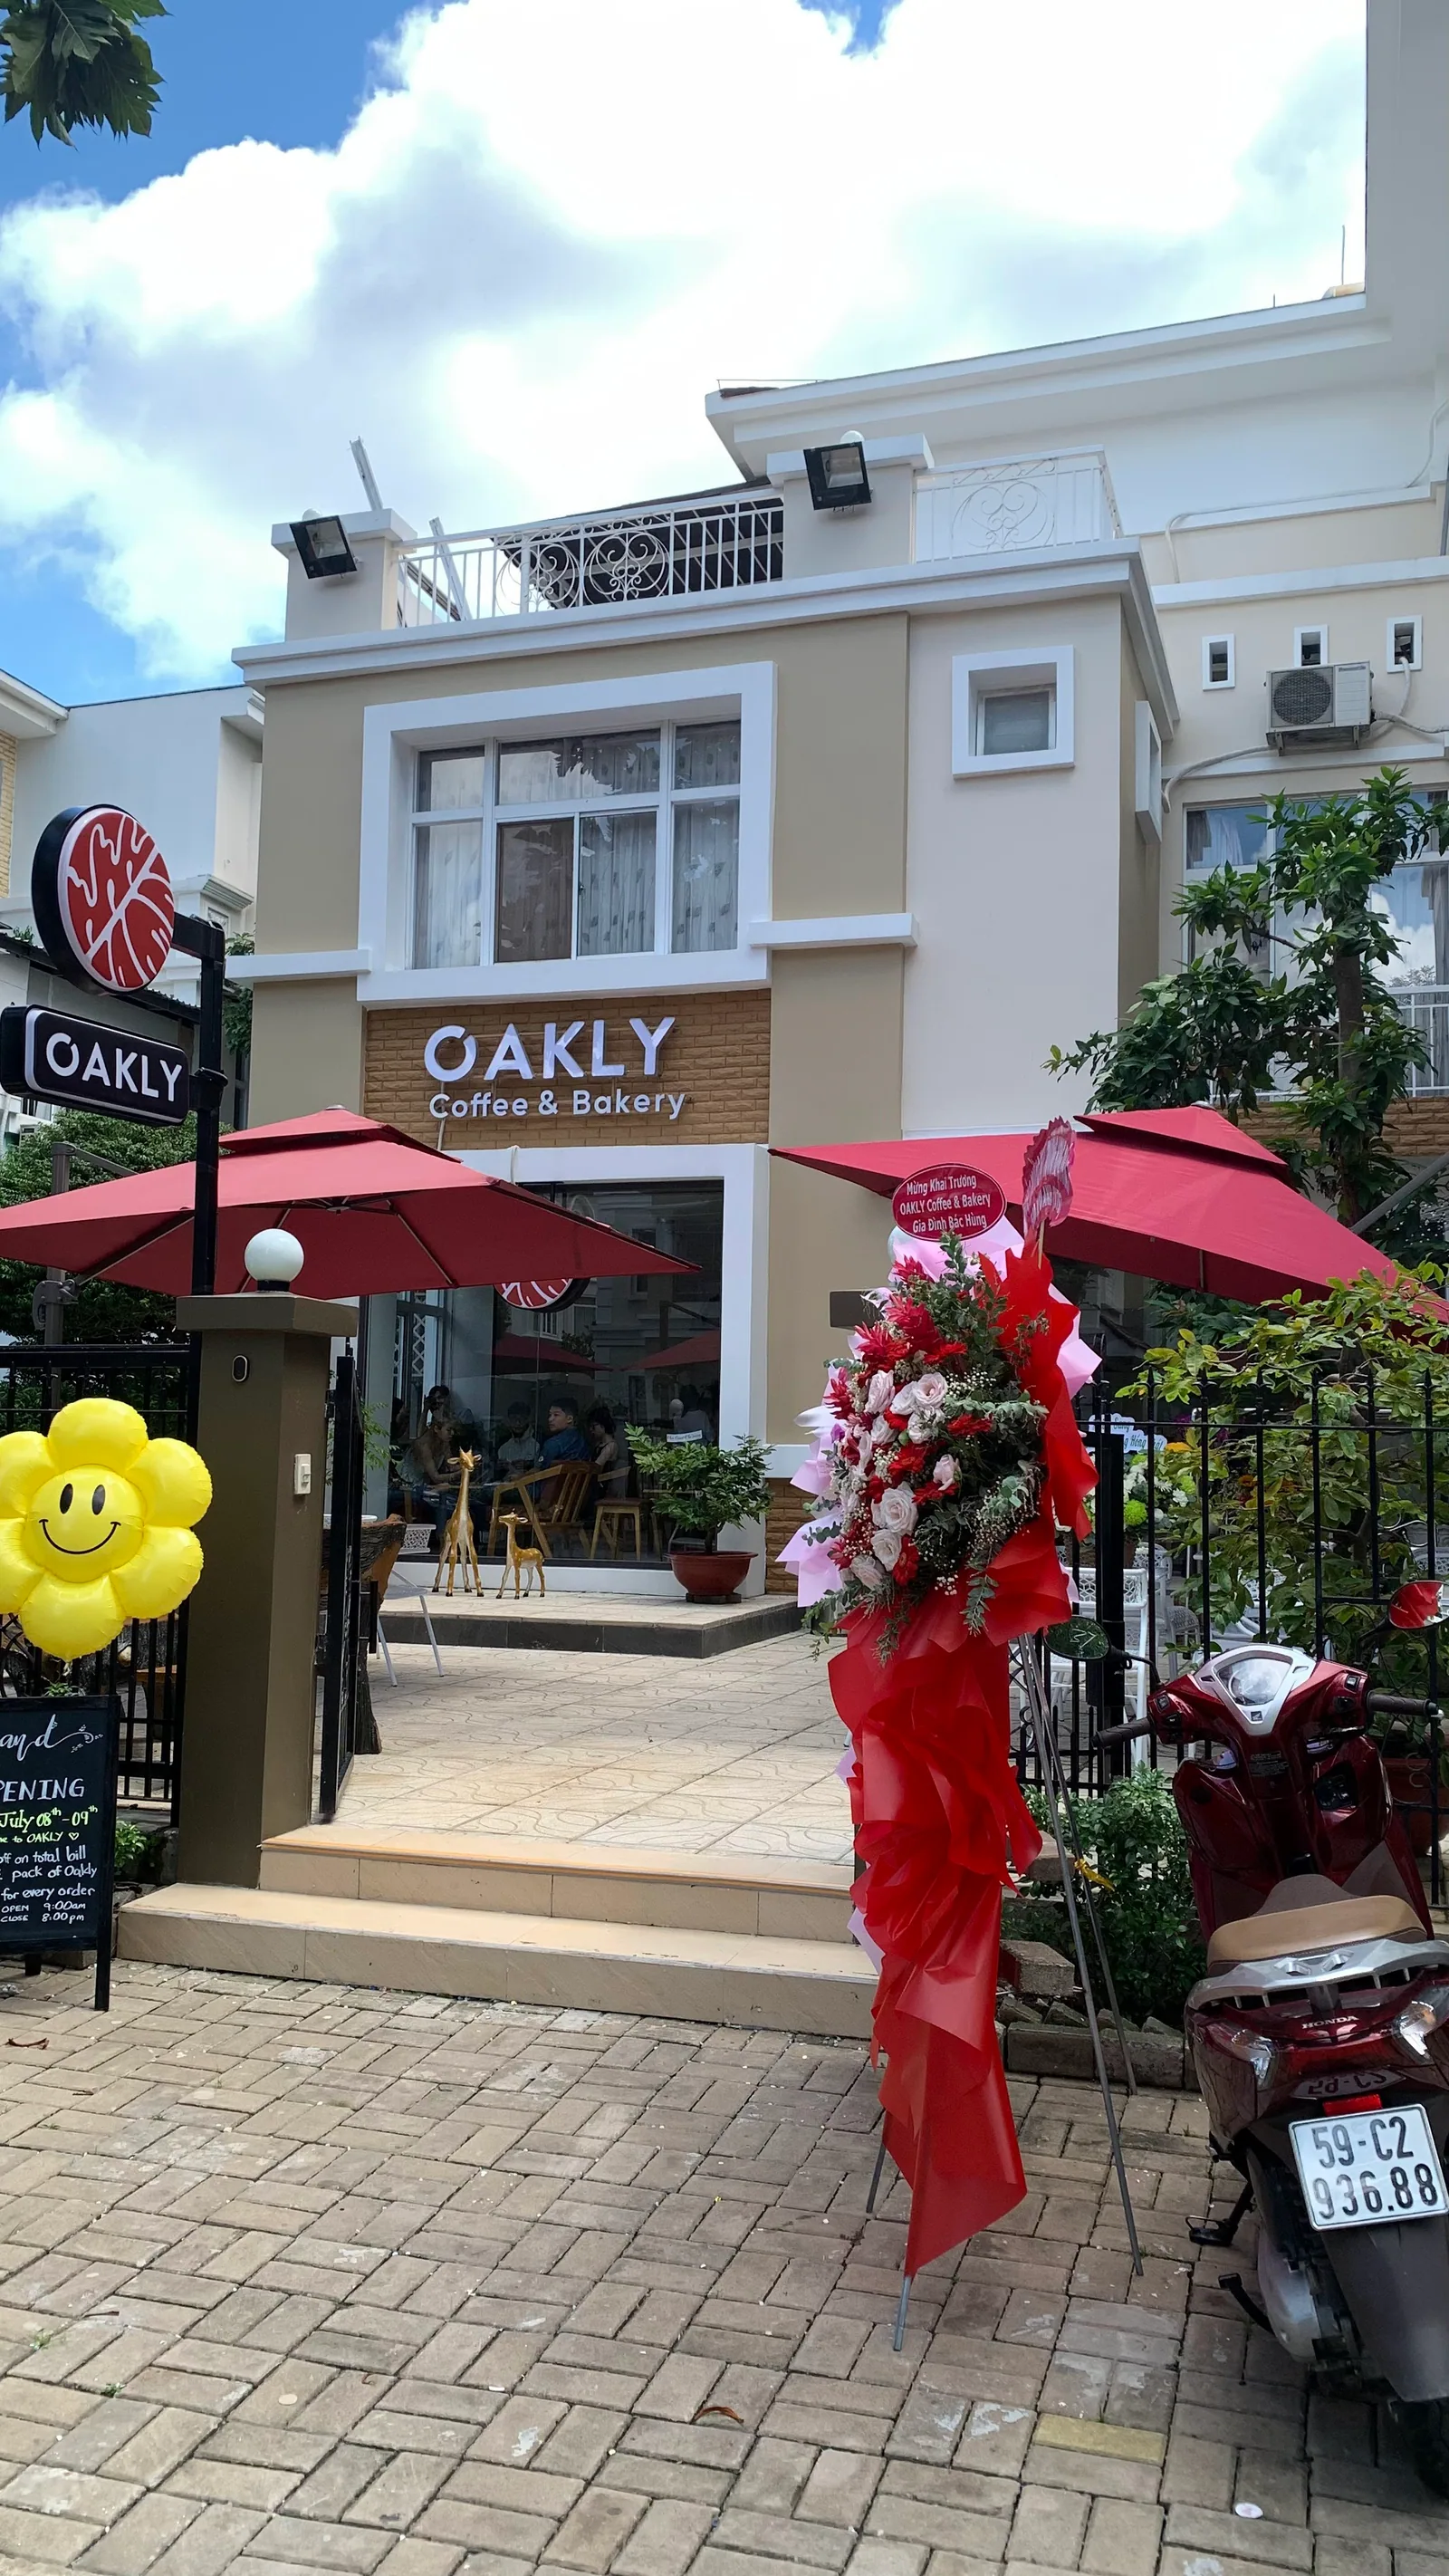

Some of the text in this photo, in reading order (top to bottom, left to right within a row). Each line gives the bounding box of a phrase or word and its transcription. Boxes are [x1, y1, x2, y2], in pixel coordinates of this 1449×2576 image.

[424, 1017, 676, 1082] OAKLY
[46, 1033, 182, 1102] OAKLY
[429, 1088, 686, 1120] Coffee & Bakery
[907, 1180, 928, 1196] Mừng
[930, 1177, 947, 1192] Khai
[899, 1192, 991, 1216] OAKLY Coffee & Bakery
[913, 1212, 987, 1233] Gia Đình Bác Hùng
[0, 1809, 35, 1833] July
[26, 1831, 64, 1843] OAKLY
[14, 1854, 29, 1864] on
[33, 1847, 61, 1863] total
[66, 1844, 86, 1861] bill
[12, 1865, 43, 1883] pack
[47, 1865, 62, 1878] of
[1, 1882, 96, 1901] for every order
[1, 1905, 30, 1913] OPEN
[1301, 2015, 1360, 2029] HONDA
[1313, 2116, 1414, 2169] 59-C2
[1313, 2163, 1438, 2219] 936.88
